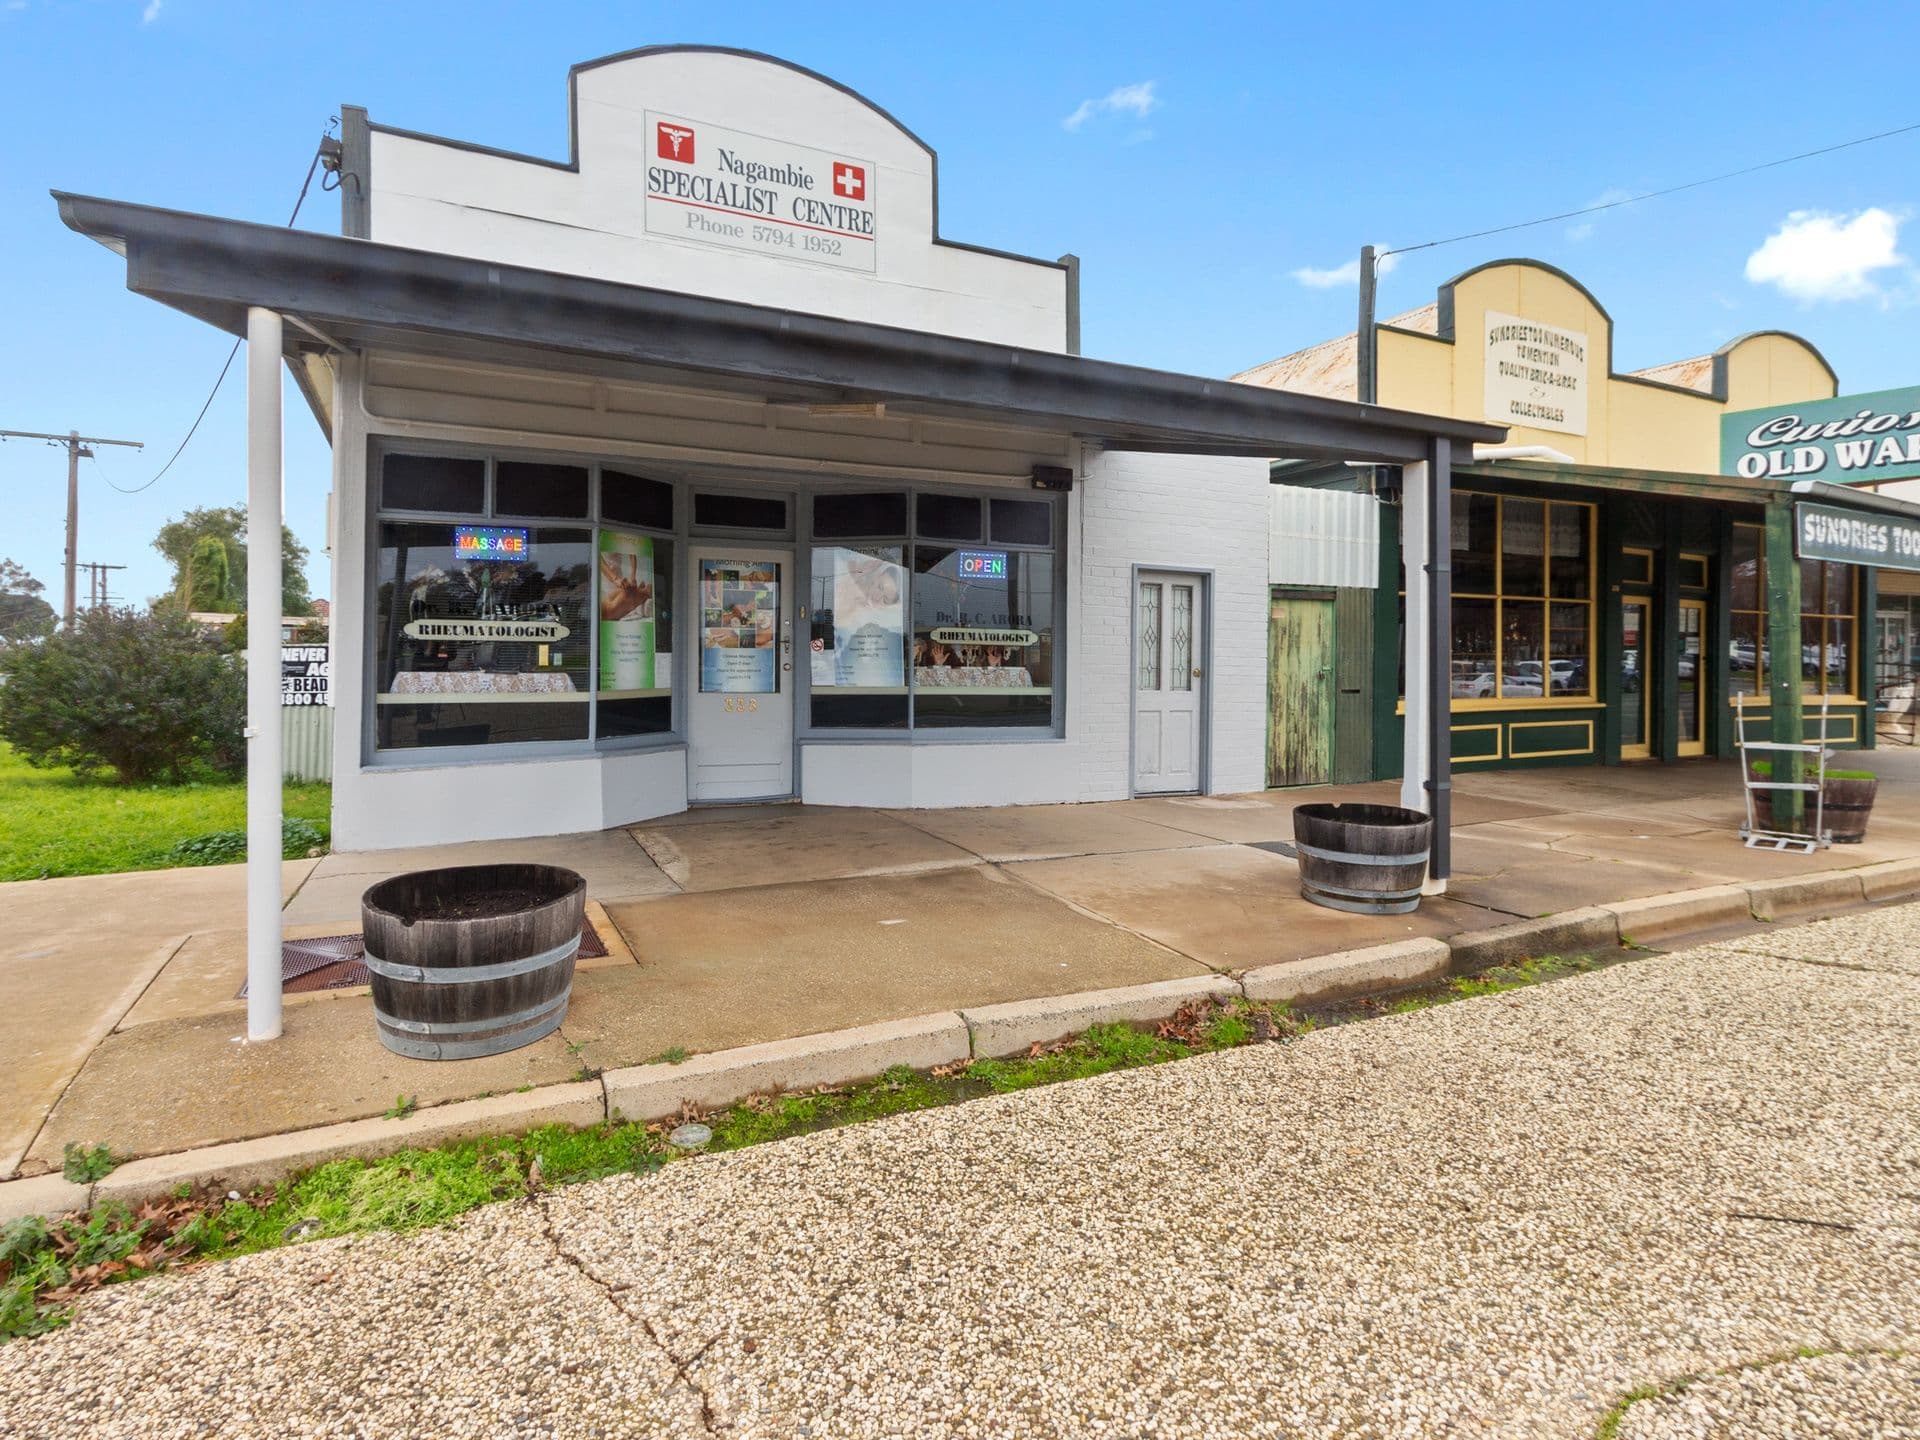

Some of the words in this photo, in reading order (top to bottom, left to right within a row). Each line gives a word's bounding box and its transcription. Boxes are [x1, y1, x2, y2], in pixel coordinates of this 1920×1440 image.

[717, 148, 815, 190] Nagambie
[648, 166, 778, 215] SPECIALIST
[792, 196, 874, 235] CENTRE
[686, 212, 744, 238] Phone
[752, 225, 796, 248] 5794
[802, 234, 842, 256] 1952
[1489, 325, 1528, 347] SUNDRIES
[1544, 333, 1584, 363] NUMEROUS
[1527, 347, 1560, 367] MENTION
[1499, 361, 1529, 380] QUALITY
[1510, 399, 1564, 423] COLLECTABLES
[1736, 446, 1828, 479] OLD
[460, 535, 523, 552] MASSAGE
[1804, 513, 1889, 553] SUNDRIES
[964, 558, 1001, 573] OPEN
[418, 624, 558, 638] RHEUMATOLOGIST
[939, 631, 1030, 643] RHEUMATOLOGIST
[281, 647, 327, 662] NEVER
